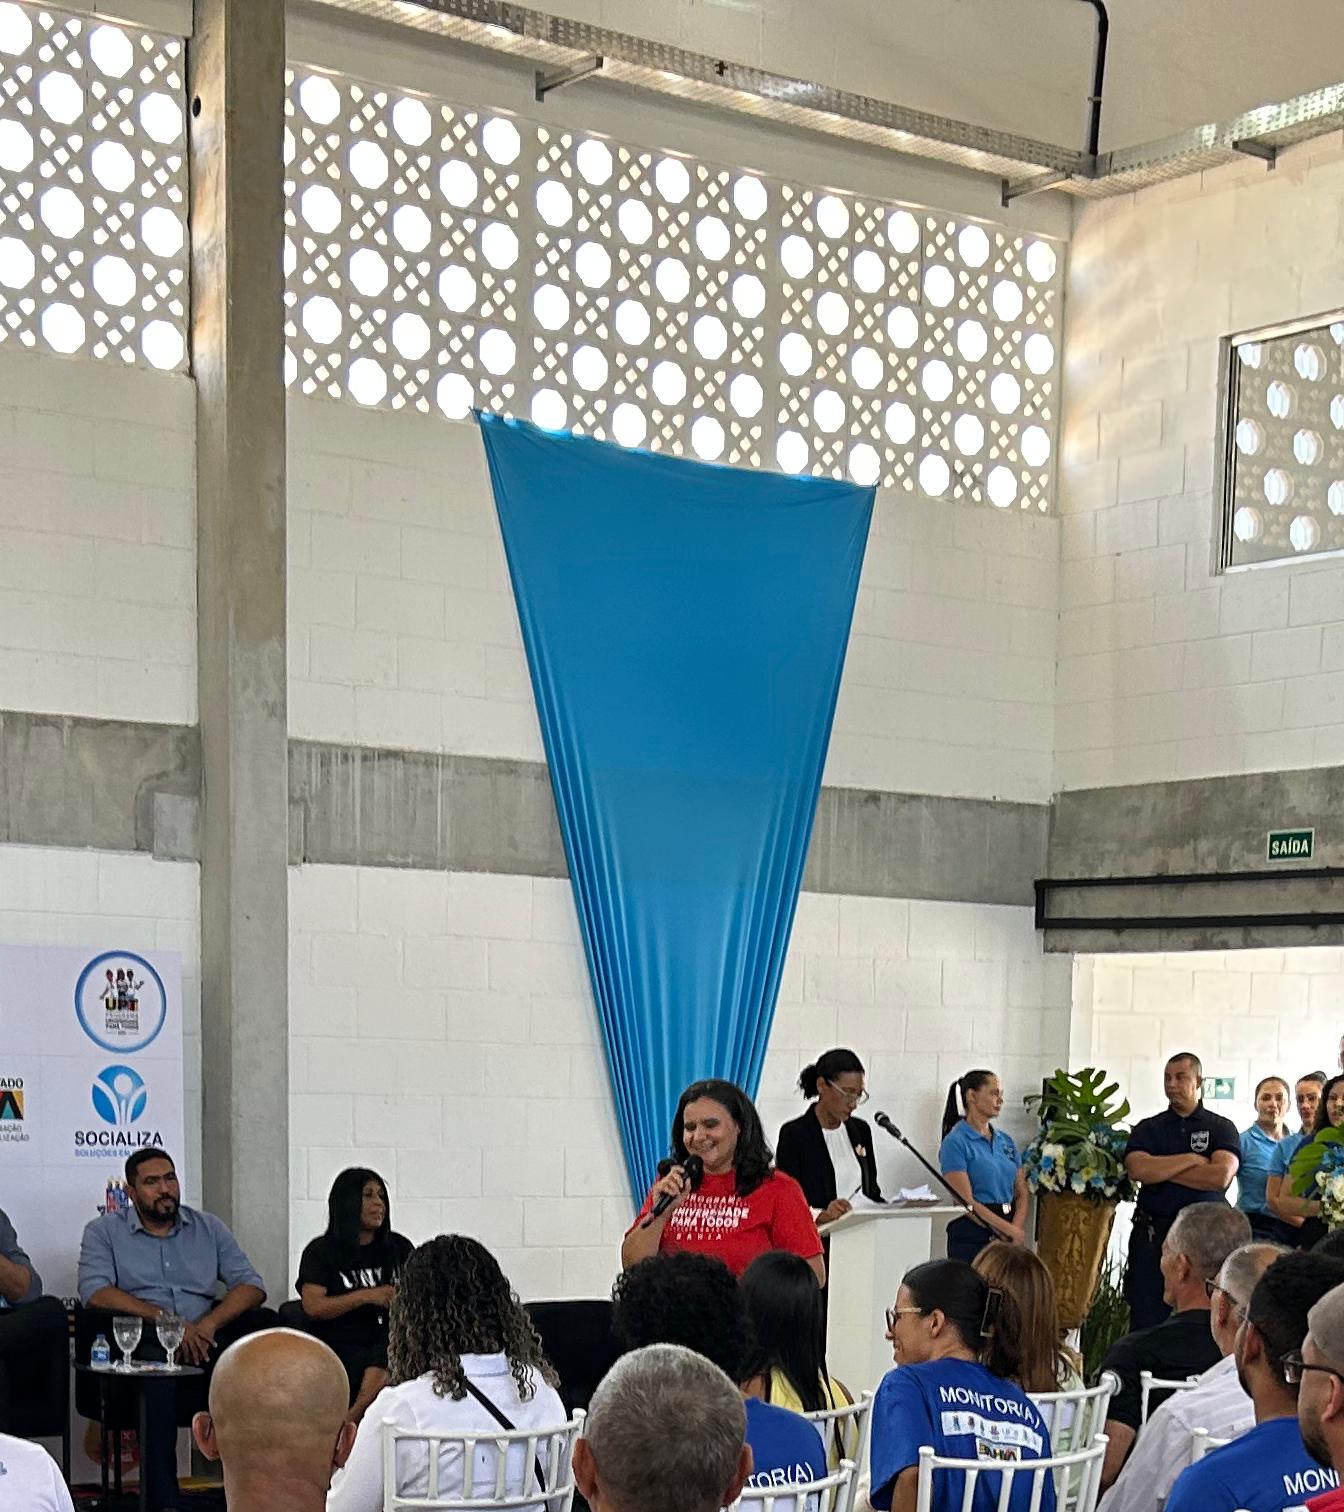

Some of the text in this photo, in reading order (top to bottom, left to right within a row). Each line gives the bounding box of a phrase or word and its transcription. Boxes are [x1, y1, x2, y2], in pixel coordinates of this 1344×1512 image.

[1271, 836, 1308, 856] SAÍDA
[74, 1131, 164, 1147] SOCIALIZA
[74, 1149, 118, 1158] SOLUÇÕES
[670, 1216, 739, 1228] PARA TODOS
[939, 1386, 1040, 1430] MONITOR(A)
